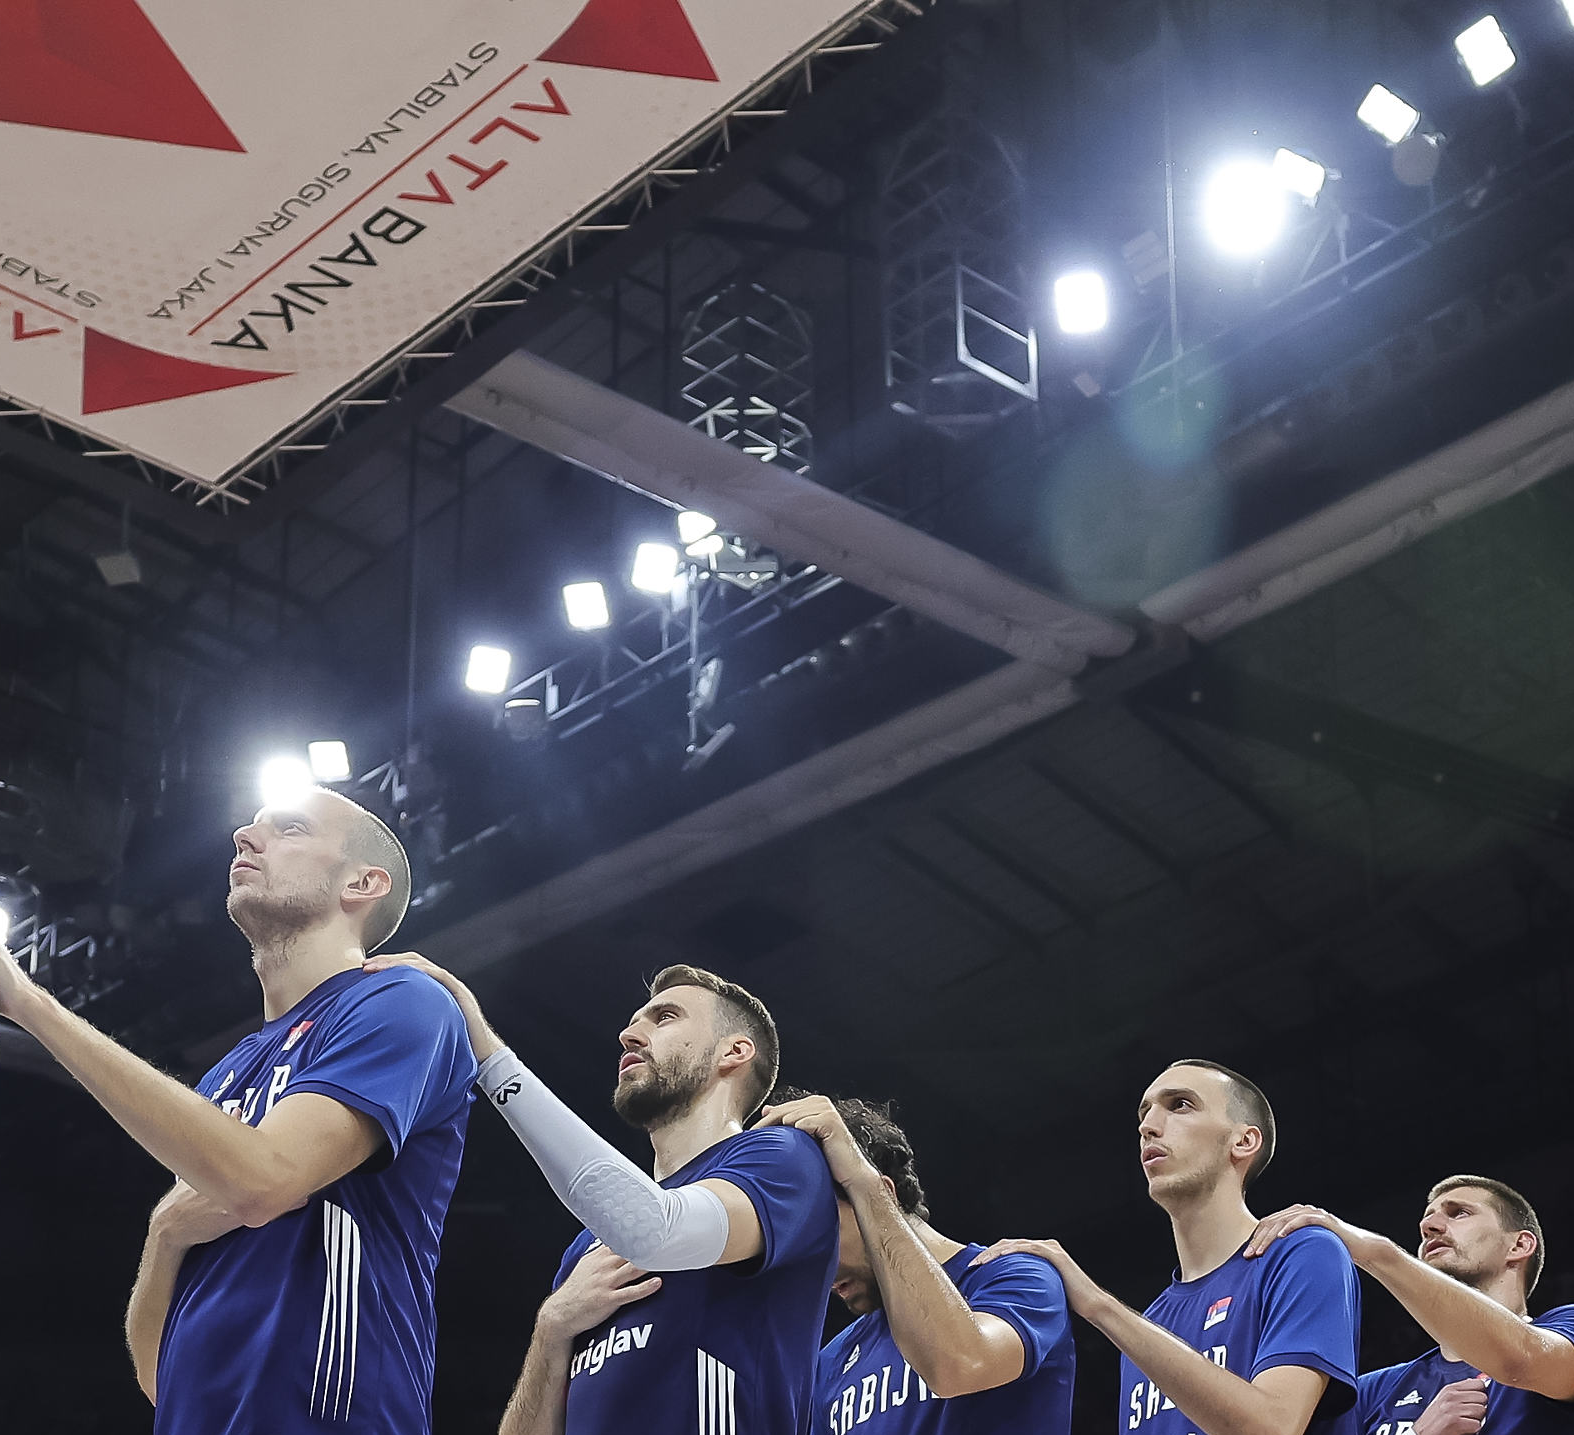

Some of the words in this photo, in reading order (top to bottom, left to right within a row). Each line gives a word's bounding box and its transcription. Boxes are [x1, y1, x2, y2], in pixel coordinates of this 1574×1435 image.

[226, 162, 351, 257] SIGURNA
[147, 266, 213, 322] JAKA
[570, 1324, 653, 1379] triglav
